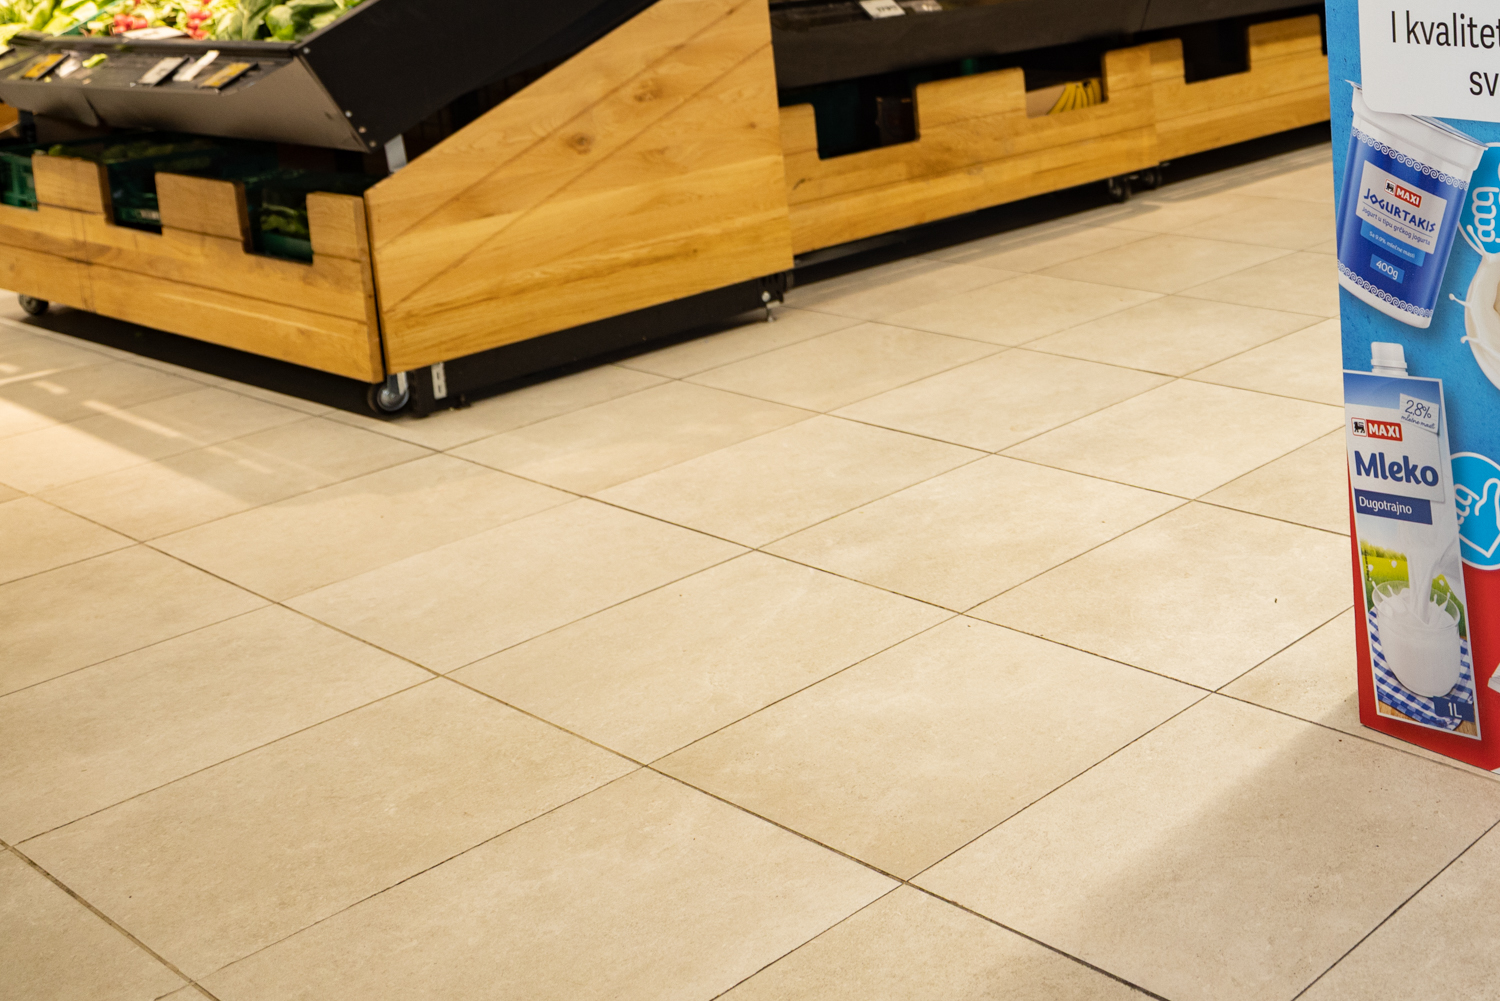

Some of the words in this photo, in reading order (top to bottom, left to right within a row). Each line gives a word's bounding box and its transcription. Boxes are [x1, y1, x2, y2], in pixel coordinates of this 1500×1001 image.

[1391, 10, 1397, 44] I
[1396, 188, 1420, 206] MAXI
[1363, 188, 1437, 233] JOGURTAKIS
[1382, 218, 1393, 228] tipu
[1412, 232, 1431, 246] jogurta
[1376, 260, 1399, 281] 400g
[1368, 422, 1400, 439] MAXI
[1354, 450, 1439, 487] Mleko
[1358, 495, 1413, 515] Dugotrajno
[1447, 701, 1463, 719] 1L
